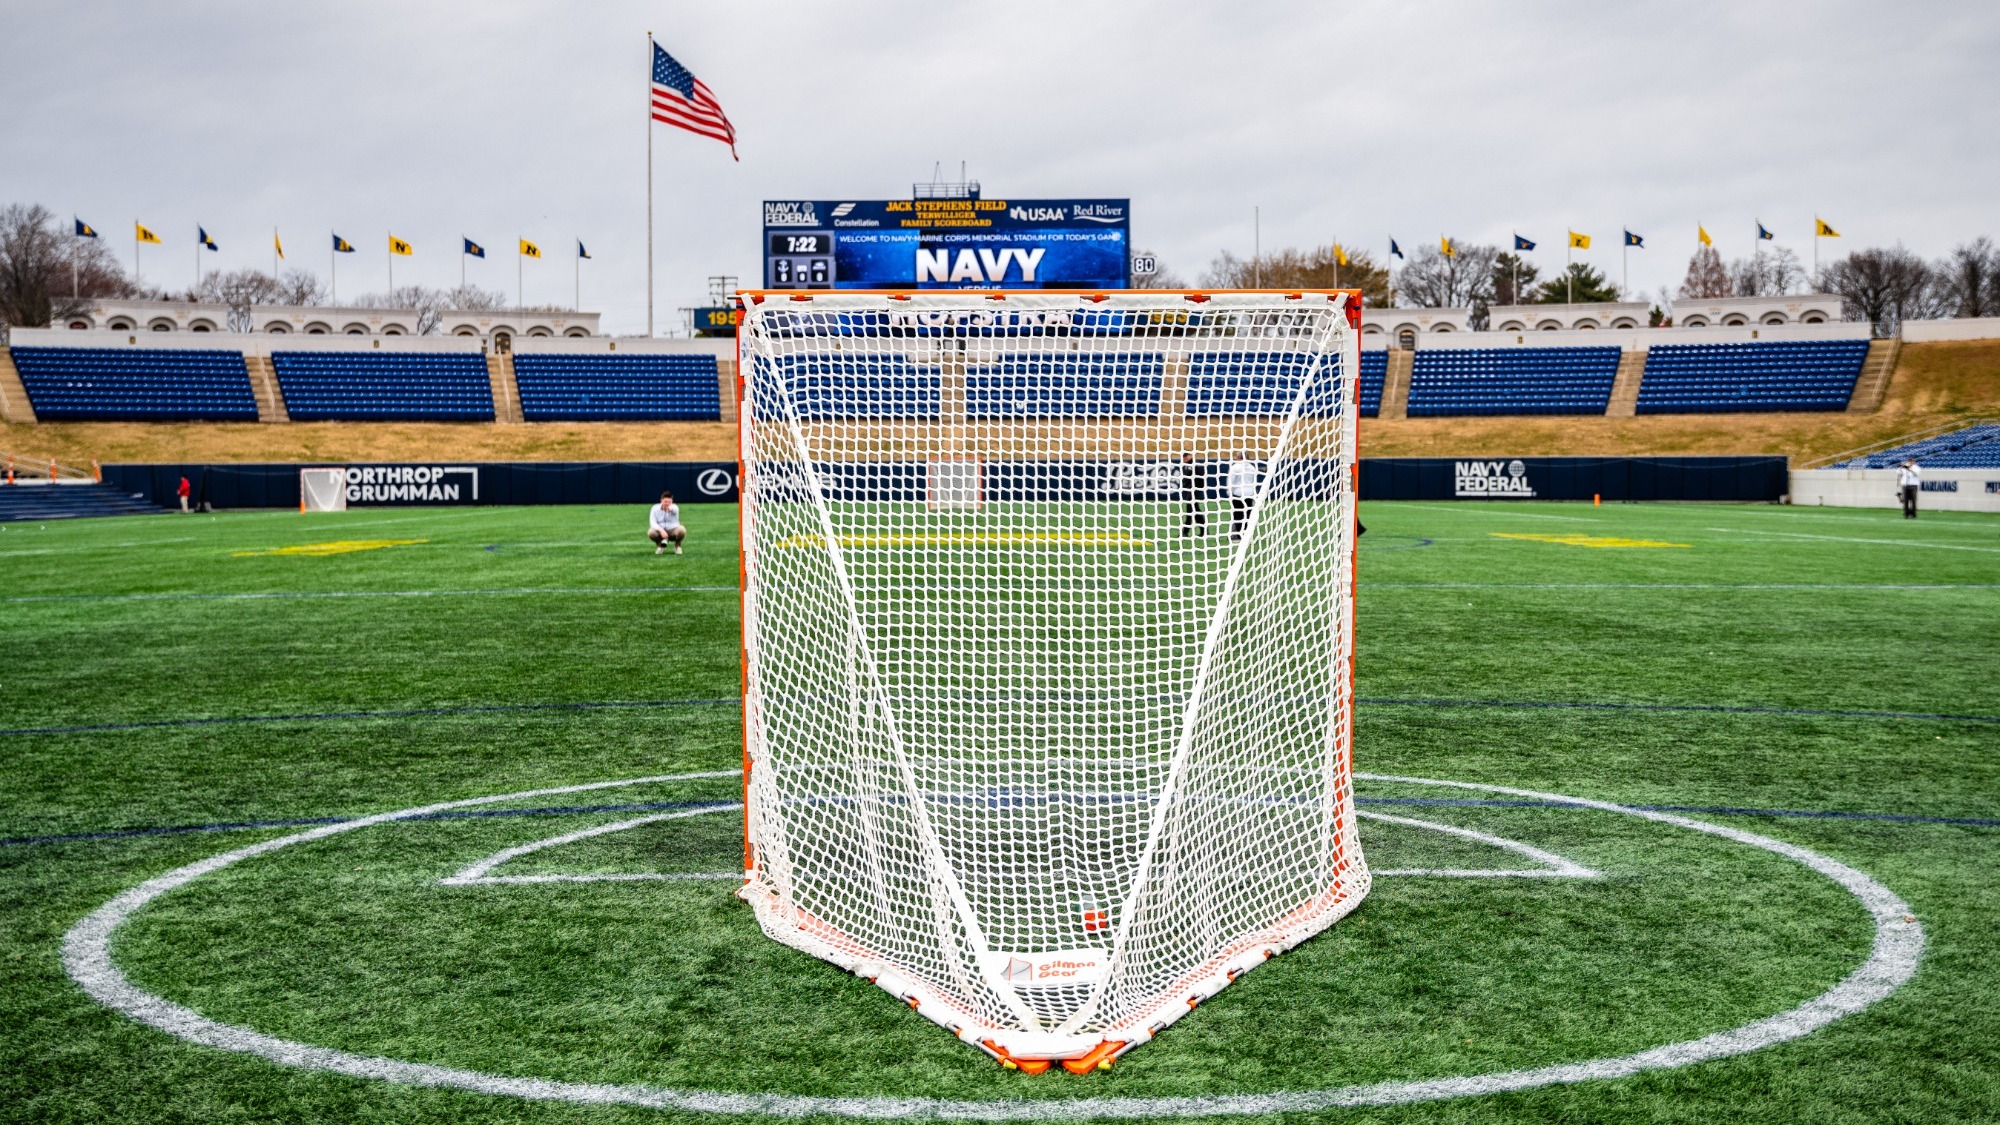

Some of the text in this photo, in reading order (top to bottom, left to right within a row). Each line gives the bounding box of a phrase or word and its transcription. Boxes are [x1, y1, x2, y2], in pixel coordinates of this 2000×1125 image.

[765, 203, 800, 213] NAVY
[886, 201, 1007, 212] JACK STEPHENS FIELD
[1073, 205, 1123, 216] Red River
[765, 213, 819, 223] FEDERAL
[916, 211, 976, 219] TERWILLIGER
[1028, 208, 1065, 221] USAA
[834, 219, 880, 227] Constellation
[934, 219, 992, 227] SCOREBOARD
[892, 234, 943, 242] NAVY-MARINE
[945, 234, 971, 242] CORPS
[972, 234, 1012, 242] MEMORIAL
[787, 236, 817, 252] 7:22
[916, 248, 1046, 282] NAVY
[1135, 259, 1154, 272] 80
[708, 311, 736, 325] 195
[329, 466, 444, 484] NORTHROP
[1455, 462, 1505, 477] NAVY
[1455, 476, 1533, 492] FEDERAL
[346, 484, 460, 501] GRUMMAN
[1038, 960, 1096, 971] Gilman
[1038, 969, 1079, 979] Gear
